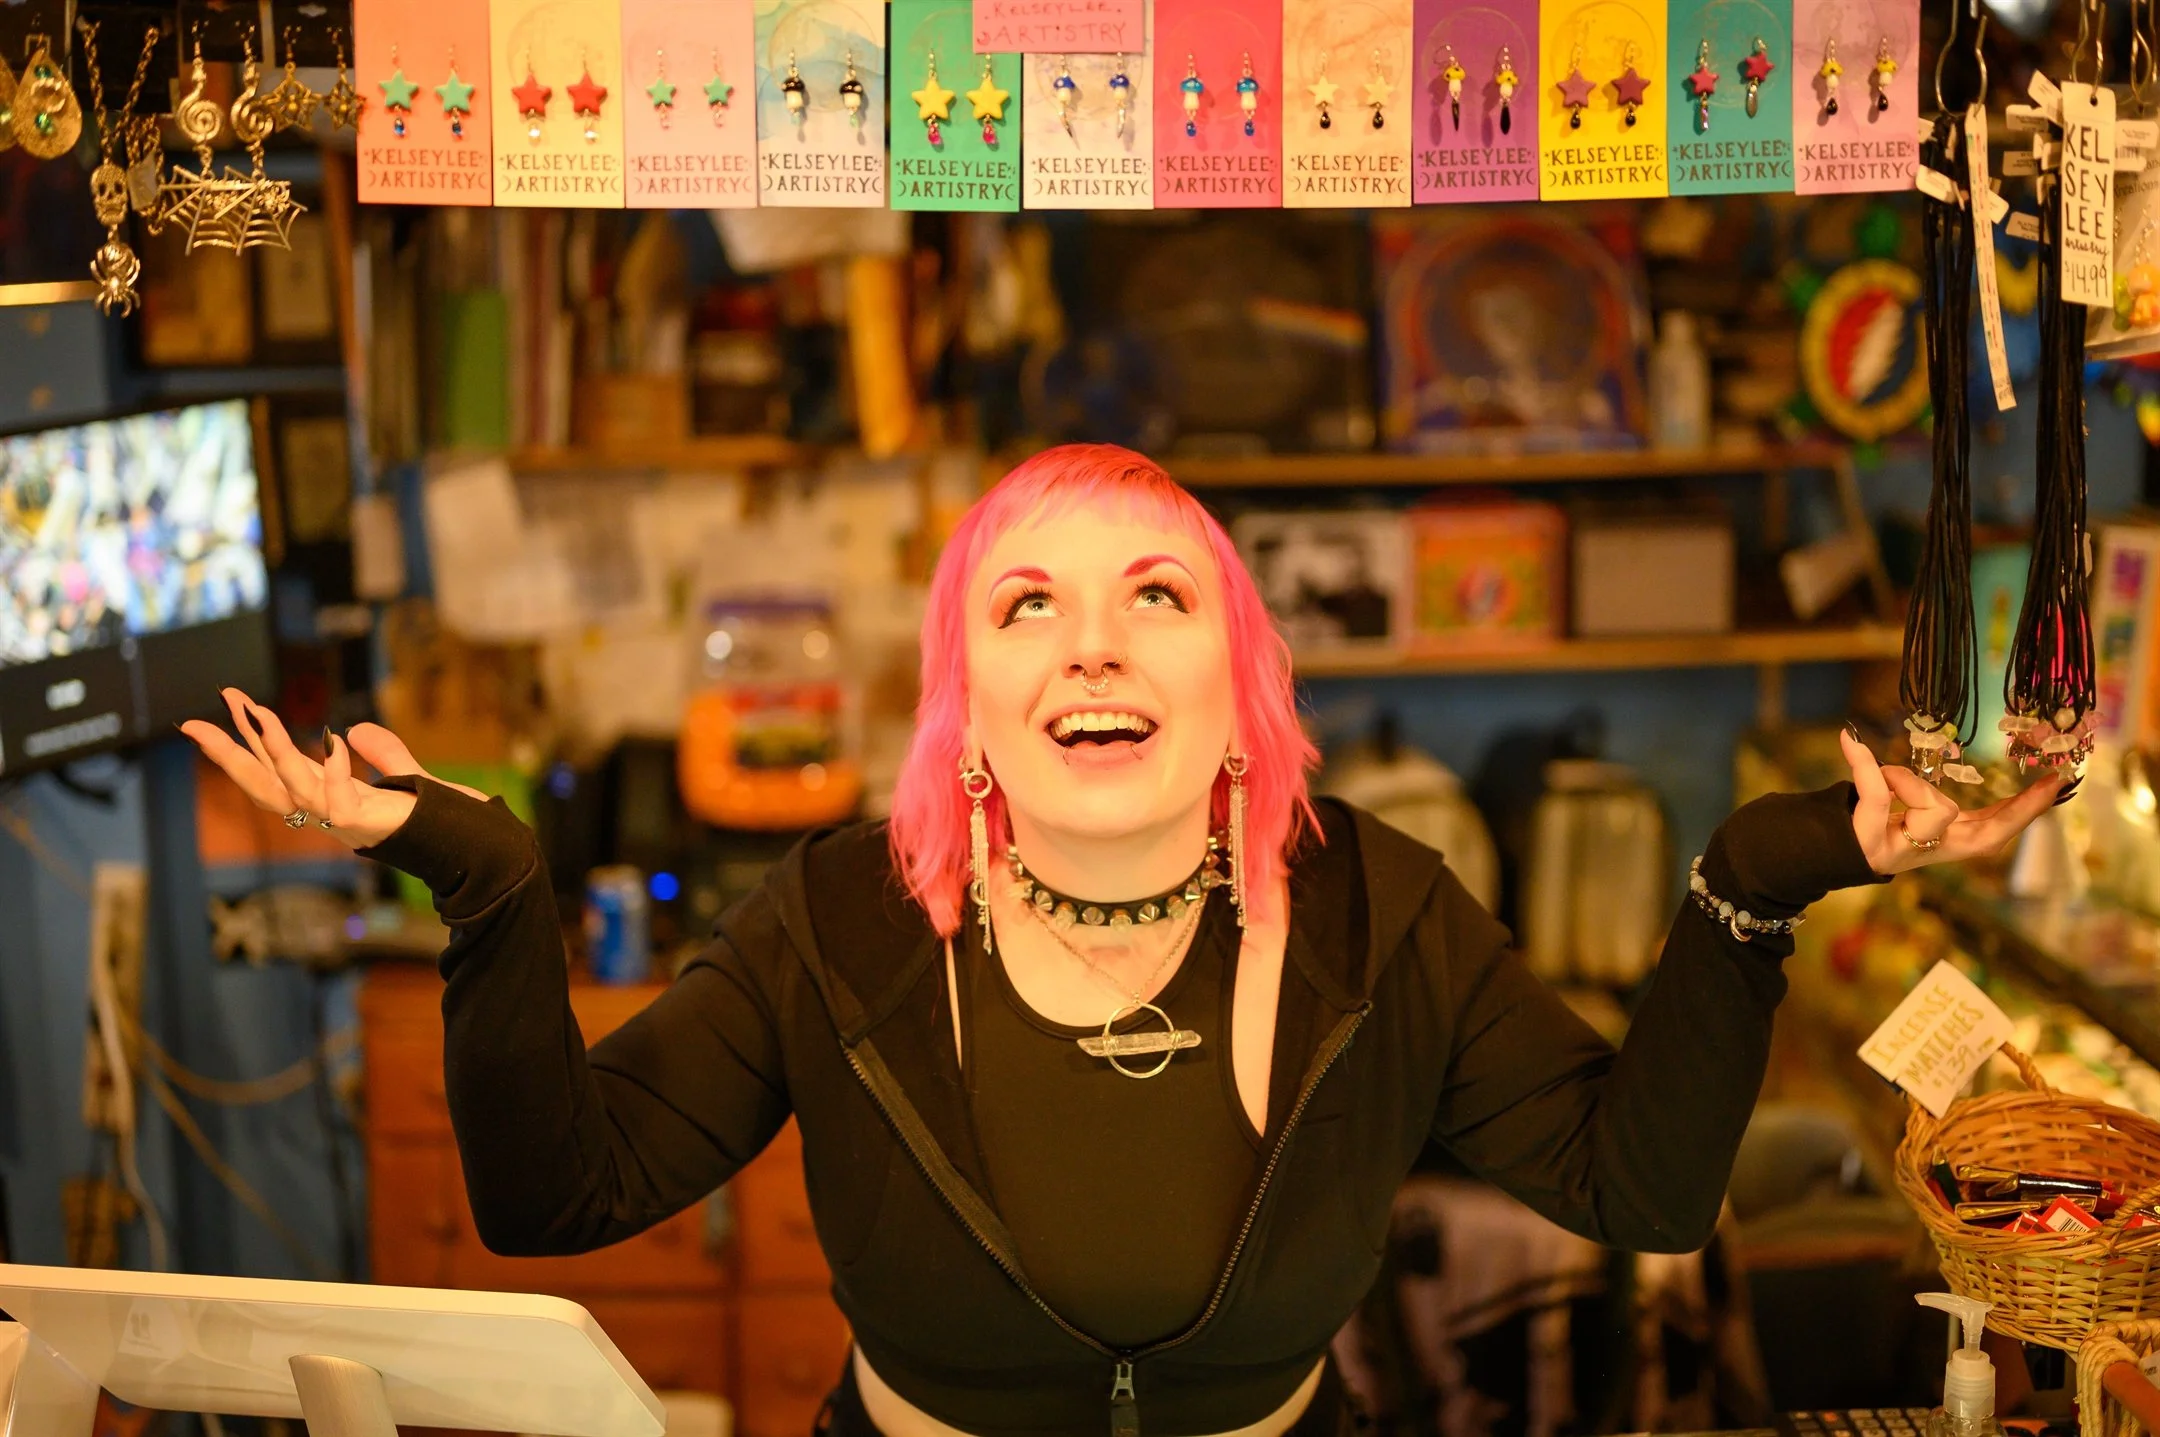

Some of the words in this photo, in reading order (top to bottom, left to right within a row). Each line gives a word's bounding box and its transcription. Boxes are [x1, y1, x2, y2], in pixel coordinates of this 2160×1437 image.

[1680, 140, 1782, 160] KELSEYLEE
[1805, 141, 1908, 161] KELSEYLEE
[2065, 122, 2110, 164] KEL
[372, 149, 479, 167] KELSEYLEE
[506, 153, 611, 171] KELSEYLEE
[638, 154, 744, 172] KELSEYLEE
[769, 153, 874, 171] KELSEYLEE
[1166, 155, 1270, 172] KELSEYLEE
[1297, 154, 1399, 172] KELSEYLEE
[1425, 147, 1528, 167] KELSEYLEE
[1552, 144, 1655, 166] KELSEYLEE
[902, 159, 1007, 179] KELSEYLEE
[1039, 157, 1142, 174] KELSEYLEE
[1689, 160, 1780, 181] ARTISTRY
[1814, 161, 1903, 181] ARTISTRY
[381, 170, 478, 189] ARTISTRY
[516, 176, 609, 193] ARTISTRY
[777, 175, 869, 194] ARTISTRY
[1305, 176, 1399, 194] ARTISTRY
[1434, 168, 1525, 189] ARTISTRY
[1561, 165, 1653, 186] ARTISTRY
[2065, 161, 2108, 208] SEY
[647, 177, 740, 194] ARTISTRY
[911, 180, 1006, 201] ARTISTRY
[1047, 179, 1142, 196] ARTISTRY
[1174, 177, 1268, 194] ARTISTRY
[2065, 202, 2106, 239] LEE
[1904, 1000, 1985, 1086] MATCHES
